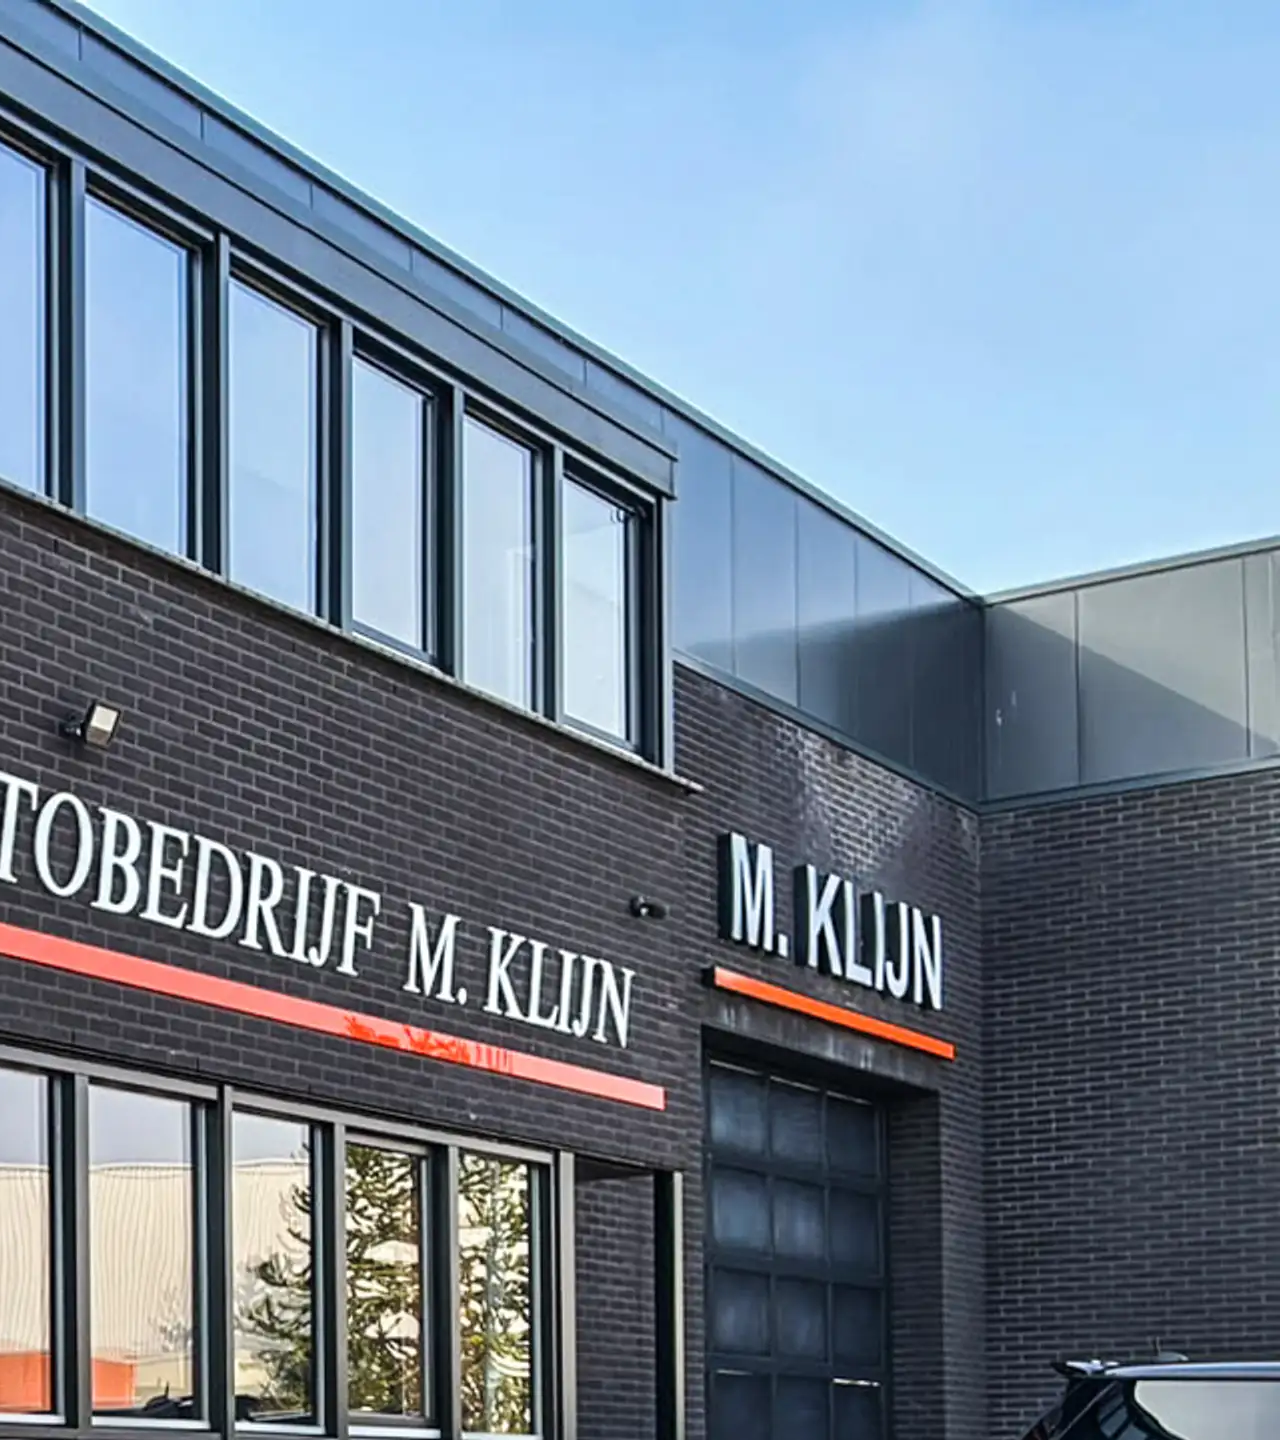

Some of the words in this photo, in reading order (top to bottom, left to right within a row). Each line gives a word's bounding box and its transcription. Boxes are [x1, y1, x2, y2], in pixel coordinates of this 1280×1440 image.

[402, 901, 469, 1008] M.
[484, 925, 636, 1050] KLIJN
[725, 831, 789, 958] M.
[804, 864, 944, 1011] KLIJN
